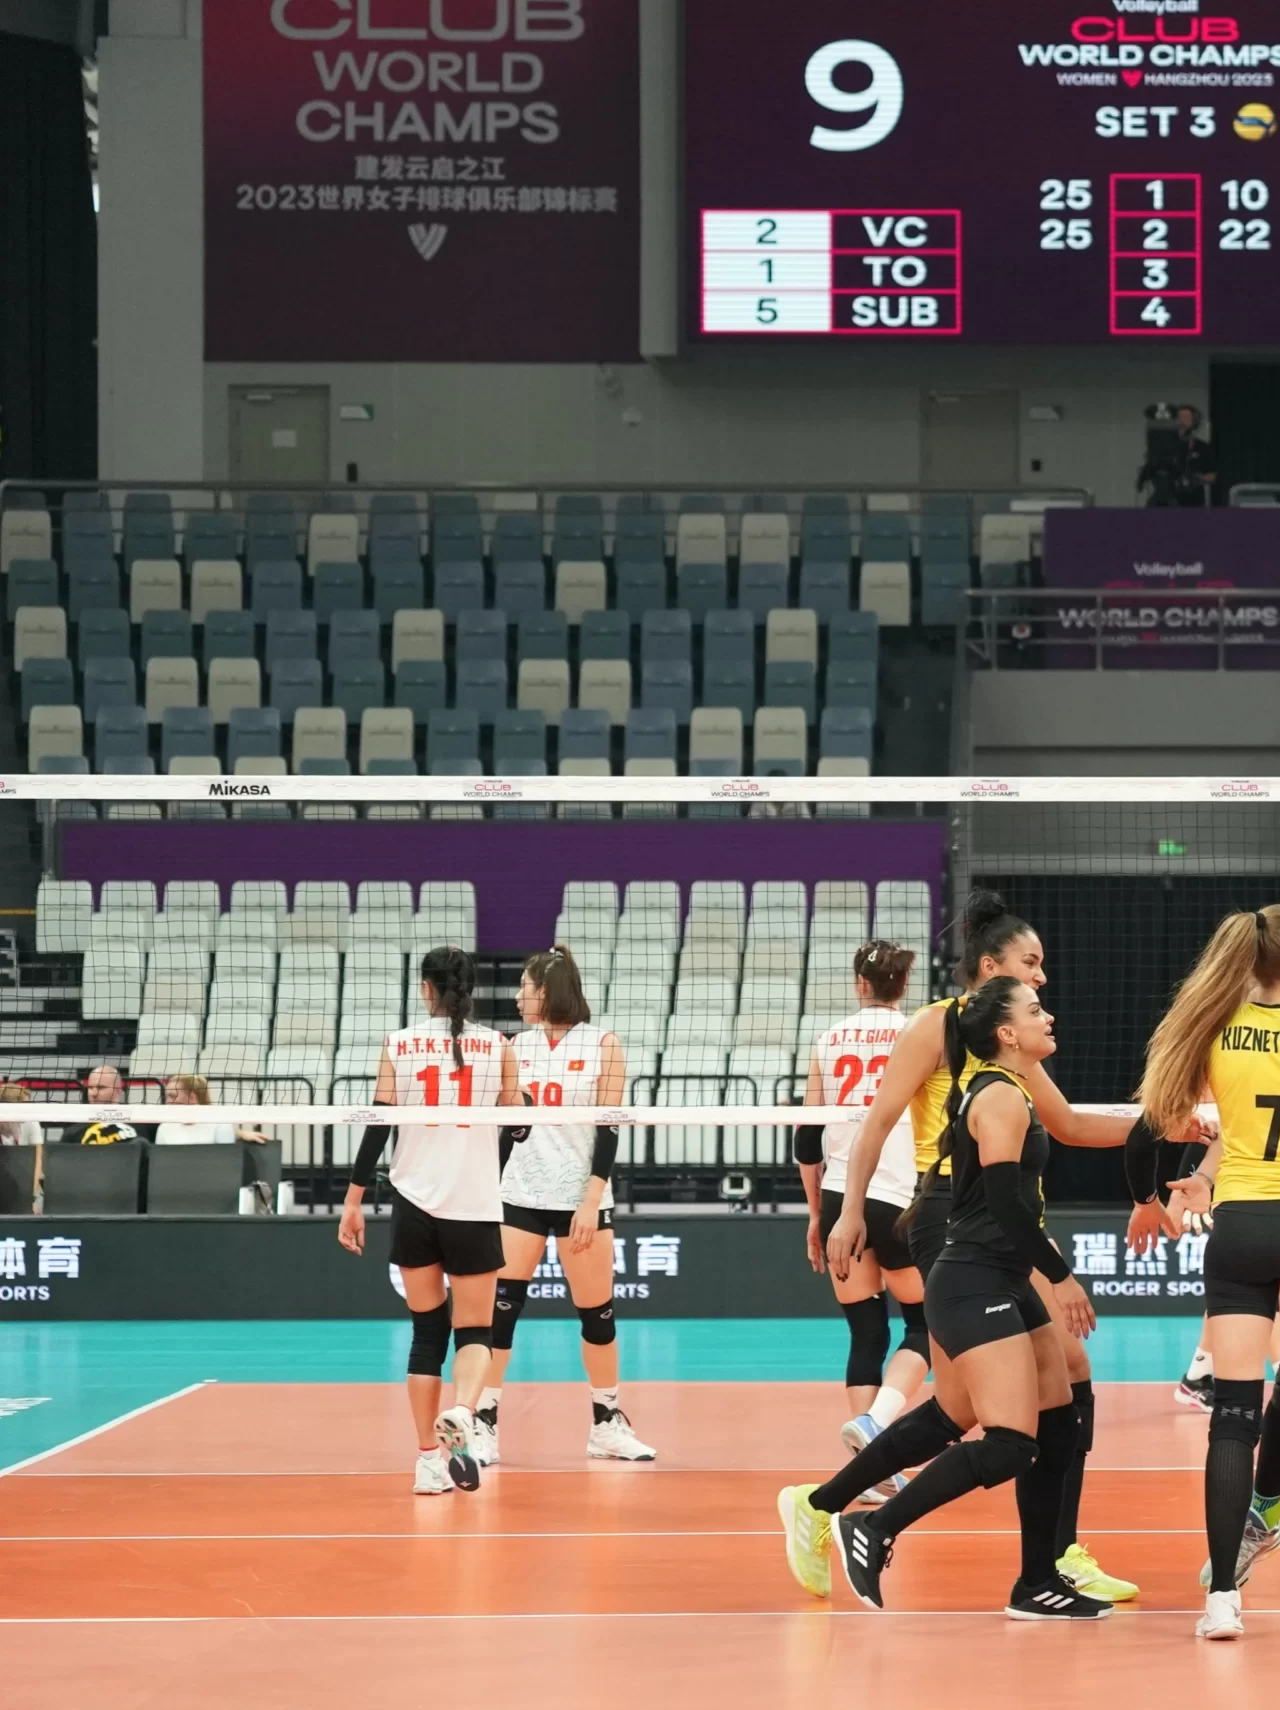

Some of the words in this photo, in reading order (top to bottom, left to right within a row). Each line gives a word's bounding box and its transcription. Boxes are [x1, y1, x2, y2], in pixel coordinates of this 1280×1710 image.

[270, 0, 585, 41] CLUB
[1070, 16, 1239, 42] CLUB
[1018, 44, 1145, 67] WORLD
[312, 51, 544, 93] WORLD
[1056, 72, 1117, 86] WOMEN
[1145, 72, 1229, 86] HANGZHOU
[1232, 72, 1274, 86] 2023
[804, 38, 904, 152] 9
[296, 100, 560, 144] CHAMPS
[1095, 106, 1178, 138] SET
[1189, 106, 1216, 138] 3
[355, 155, 505, 181] 建发云启之江
[1039, 178, 1093, 211] 25
[1145, 179, 1165, 210] 1
[1219, 178, 1269, 211] 10
[755, 218, 778, 245] 2
[862, 215, 928, 248] VC
[1039, 218, 1093, 250] 25
[1142, 219, 1168, 250] 2
[1218, 218, 1271, 250] 22
[759, 258, 775, 284] 1
[862, 255, 927, 288] TO
[1142, 258, 1169, 290] 3
[755, 298, 779, 324] 5
[851, 295, 939, 328] SUB
[1140, 298, 1170, 327] 4
[1133, 562, 1203, 579] Volleyball
[1058, 608, 1158, 628] WORLD
[1164, 607, 1278, 627] CHAMPS
[416, 1065, 473, 1116] 11
[1092, 1281, 1160, 1296] ROGER
